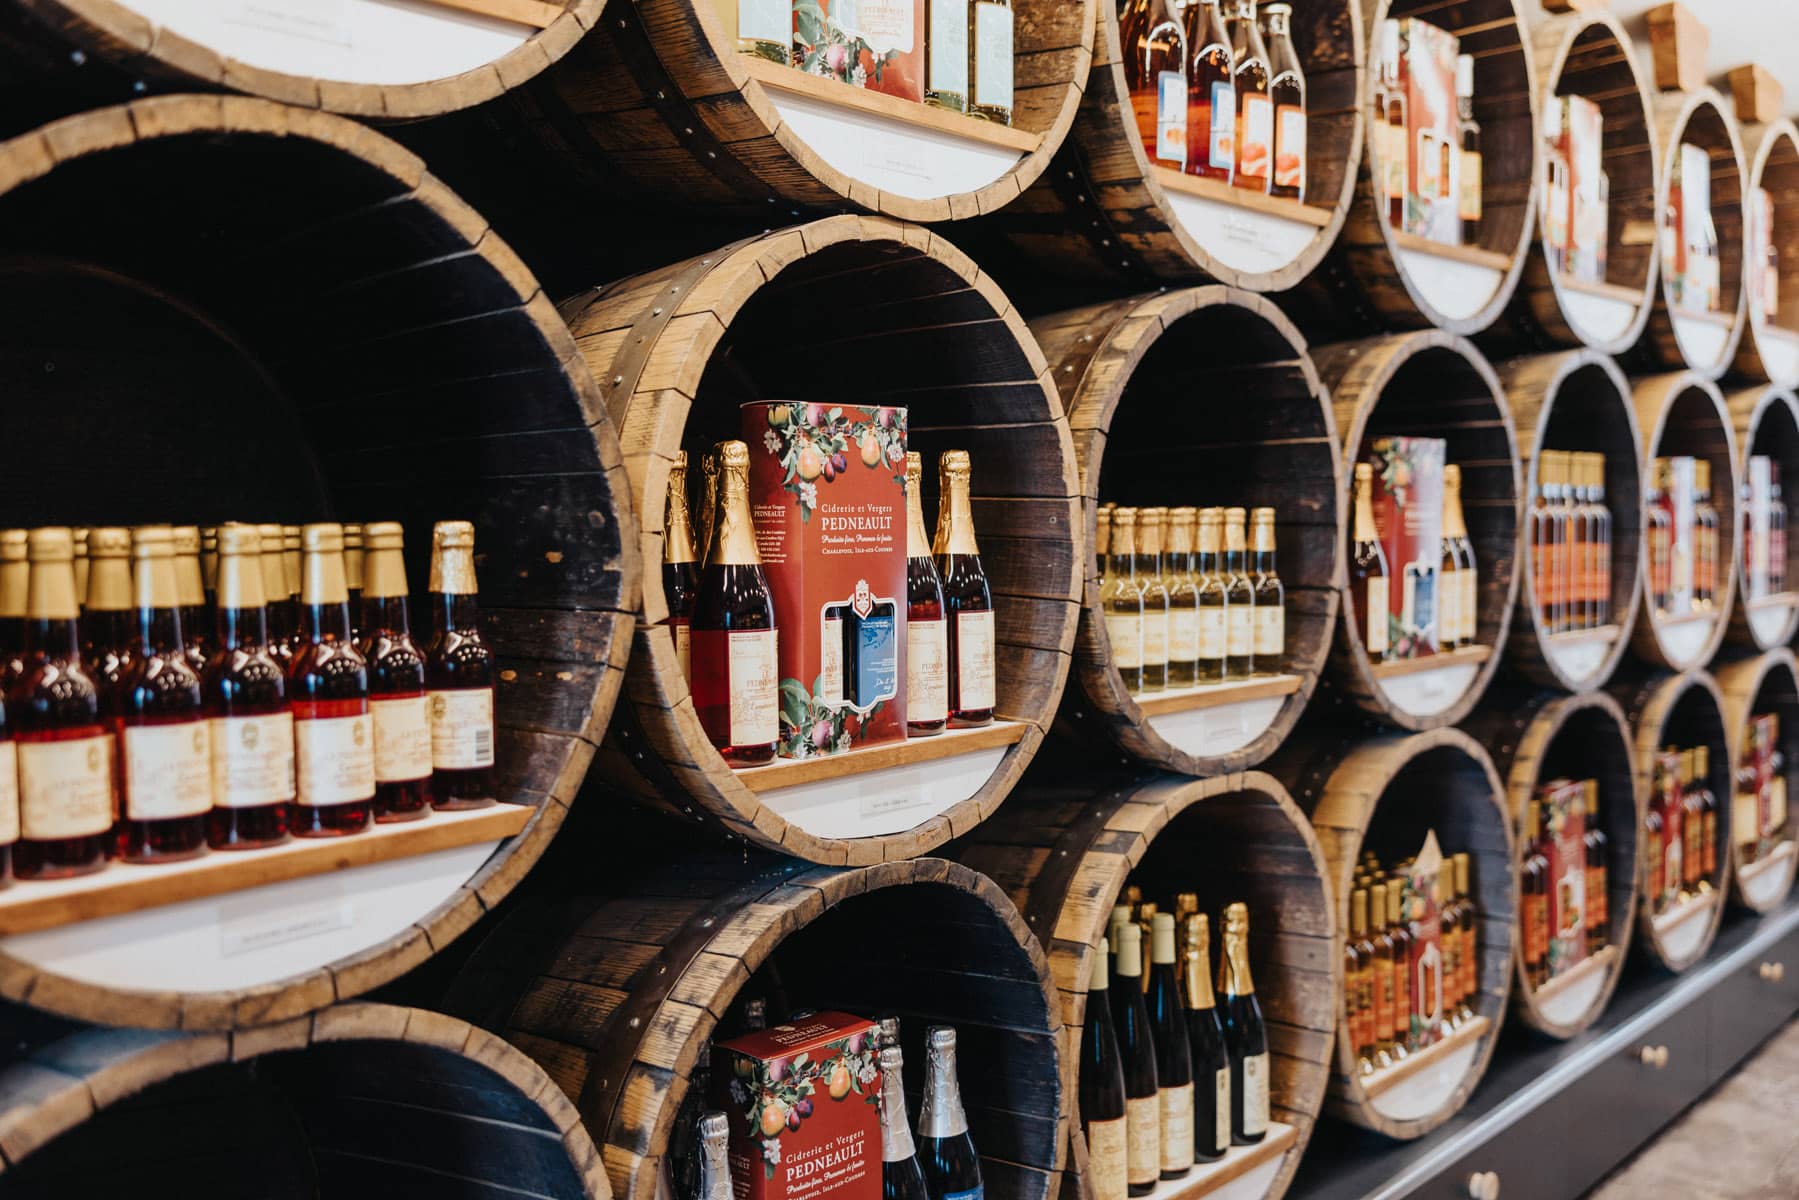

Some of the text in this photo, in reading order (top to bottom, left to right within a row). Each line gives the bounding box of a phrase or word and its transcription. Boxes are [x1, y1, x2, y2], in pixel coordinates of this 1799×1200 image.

[821, 503, 893, 515] Cidrerie et Vergers
[821, 516, 893, 531] PEDNEAULT
[786, 1129, 865, 1164] Cidrerie et Vergers
[786, 1140, 865, 1182] PEDNEAULT
